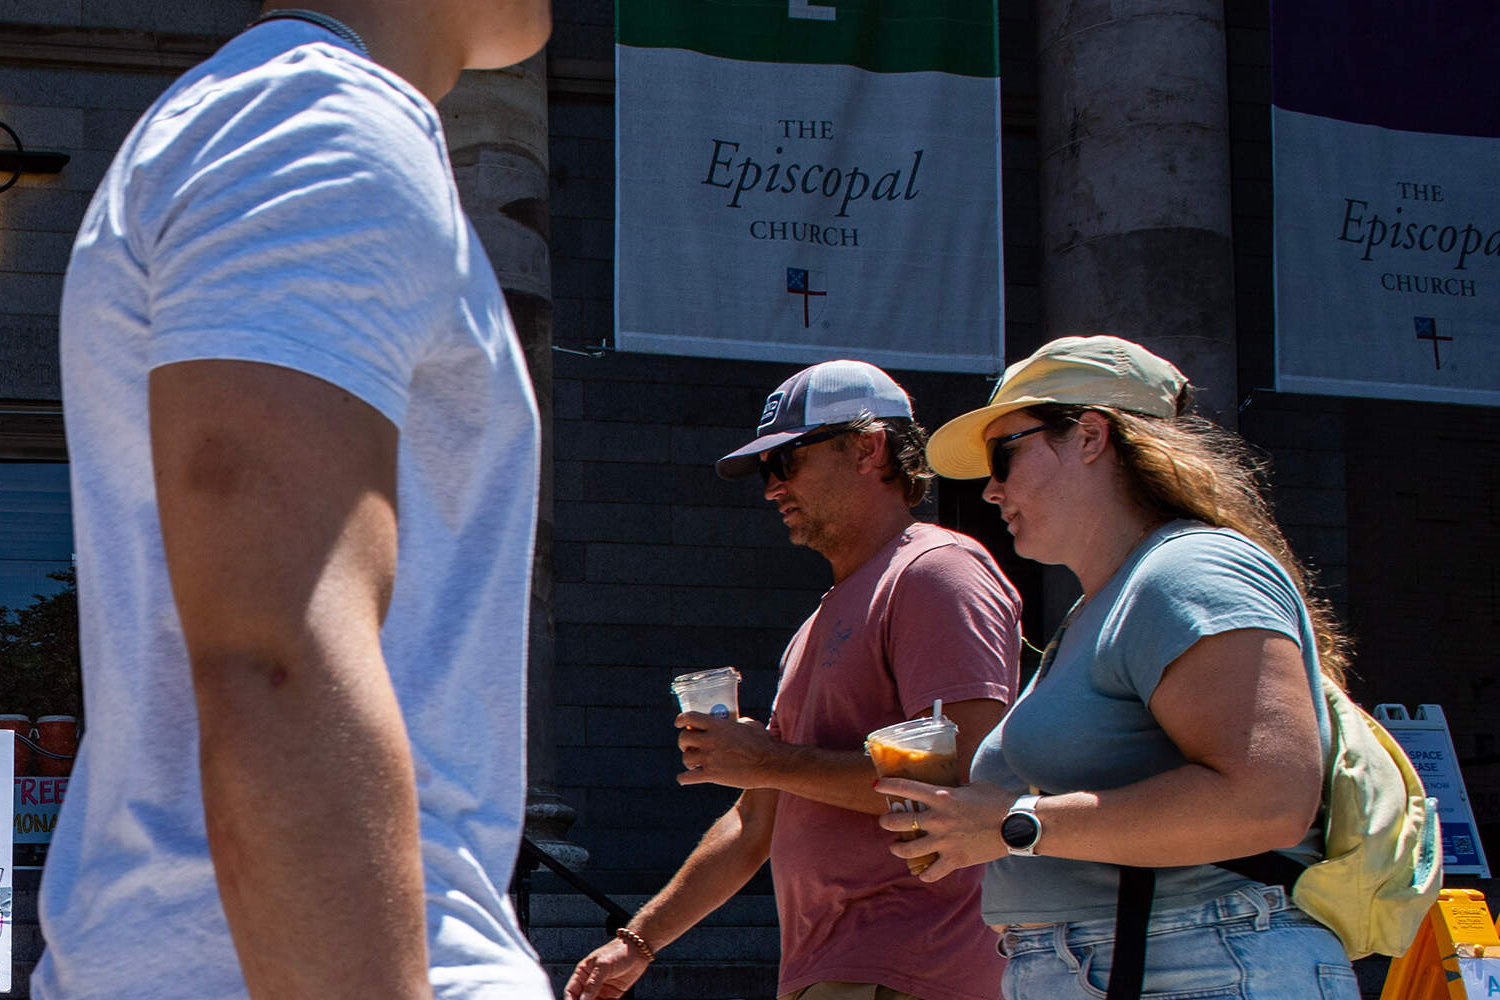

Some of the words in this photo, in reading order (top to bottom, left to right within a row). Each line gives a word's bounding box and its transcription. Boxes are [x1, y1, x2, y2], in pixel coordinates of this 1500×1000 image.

[778, 119, 834, 140] THE
[701, 138, 924, 217] Episcopal
[1396, 181, 1444, 202] THE
[749, 220, 859, 247] CHURCH
[1381, 272, 1476, 297] CHURCH
[1408, 750, 1444, 761] SPACE
